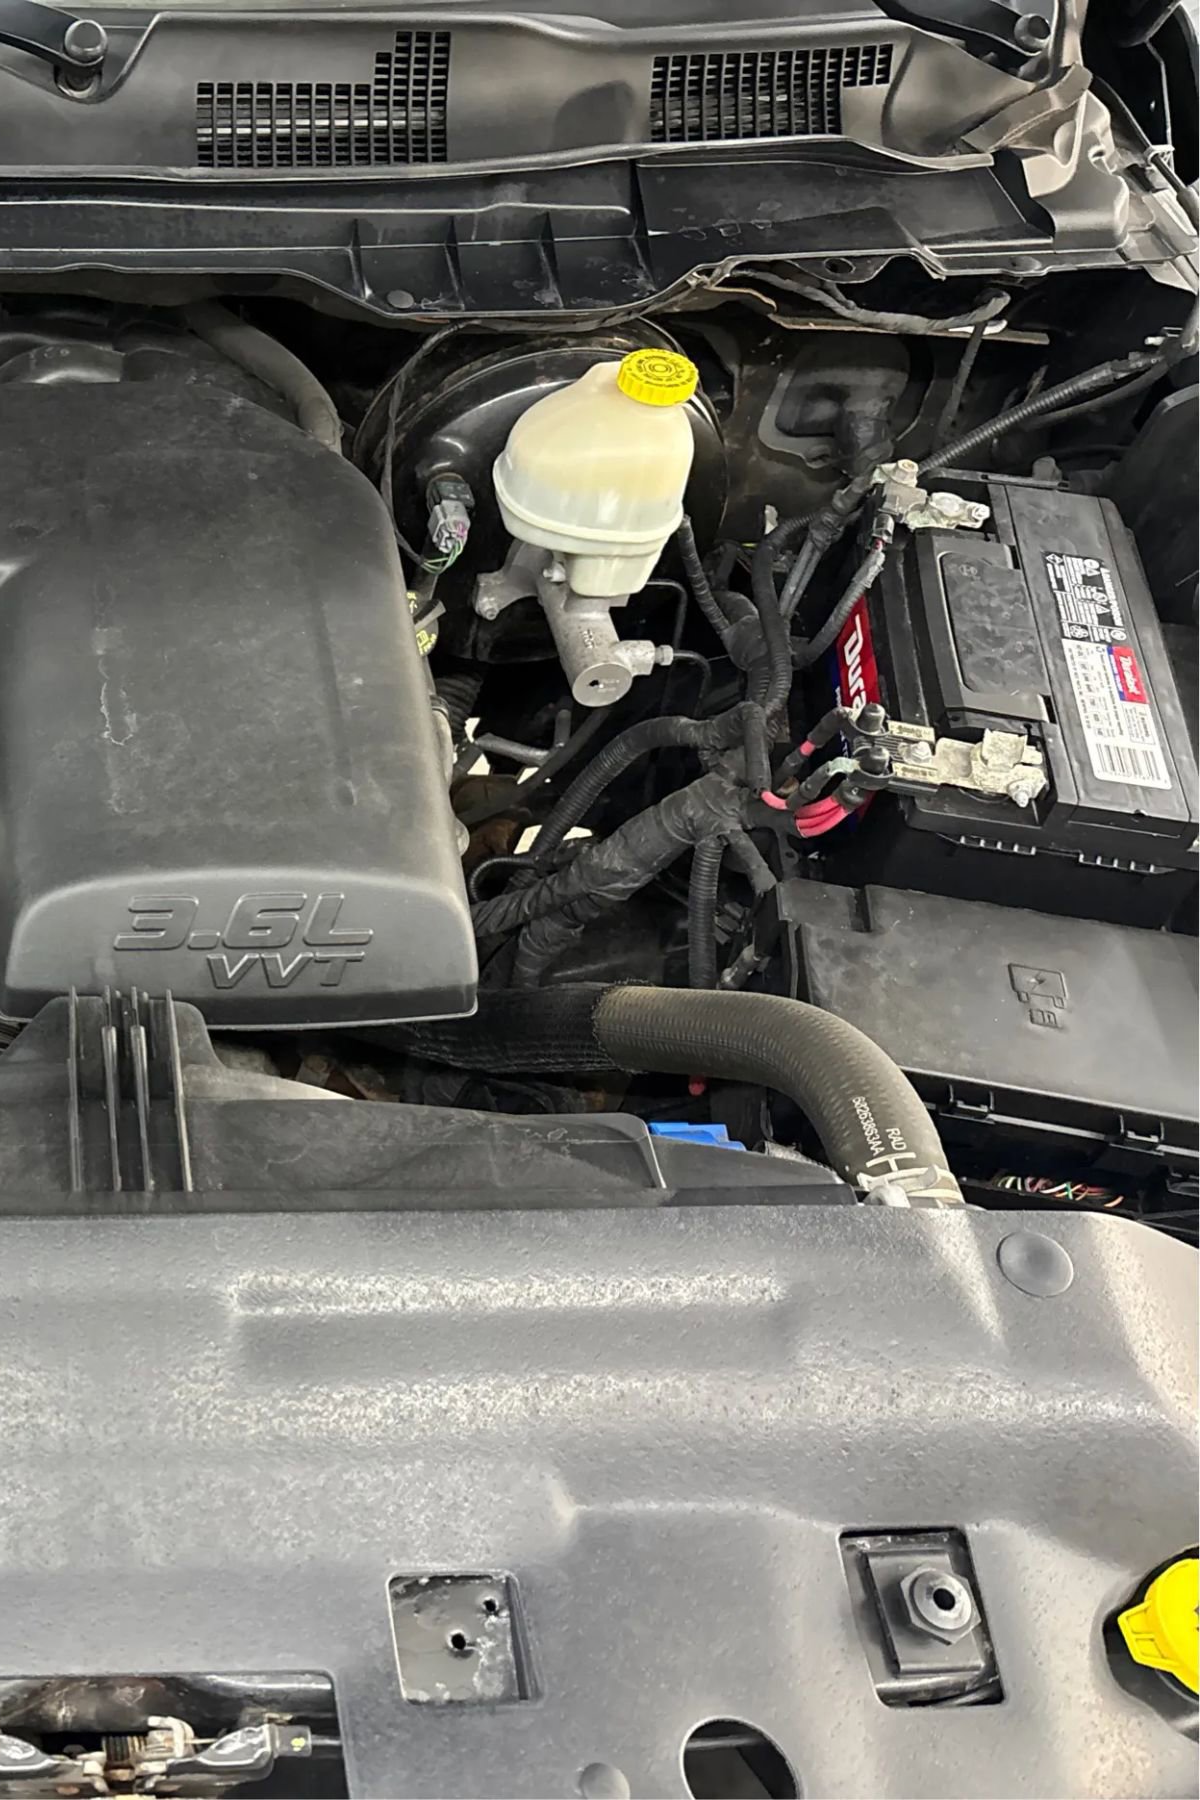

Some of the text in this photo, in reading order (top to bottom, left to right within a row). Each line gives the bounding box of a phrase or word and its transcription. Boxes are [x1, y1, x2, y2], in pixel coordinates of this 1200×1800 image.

[844, 613, 867, 712] Dura
[113, 892, 374, 951] 3.6L
[206, 952, 366, 989] VVT
[885, 1128, 907, 1151] RAD
